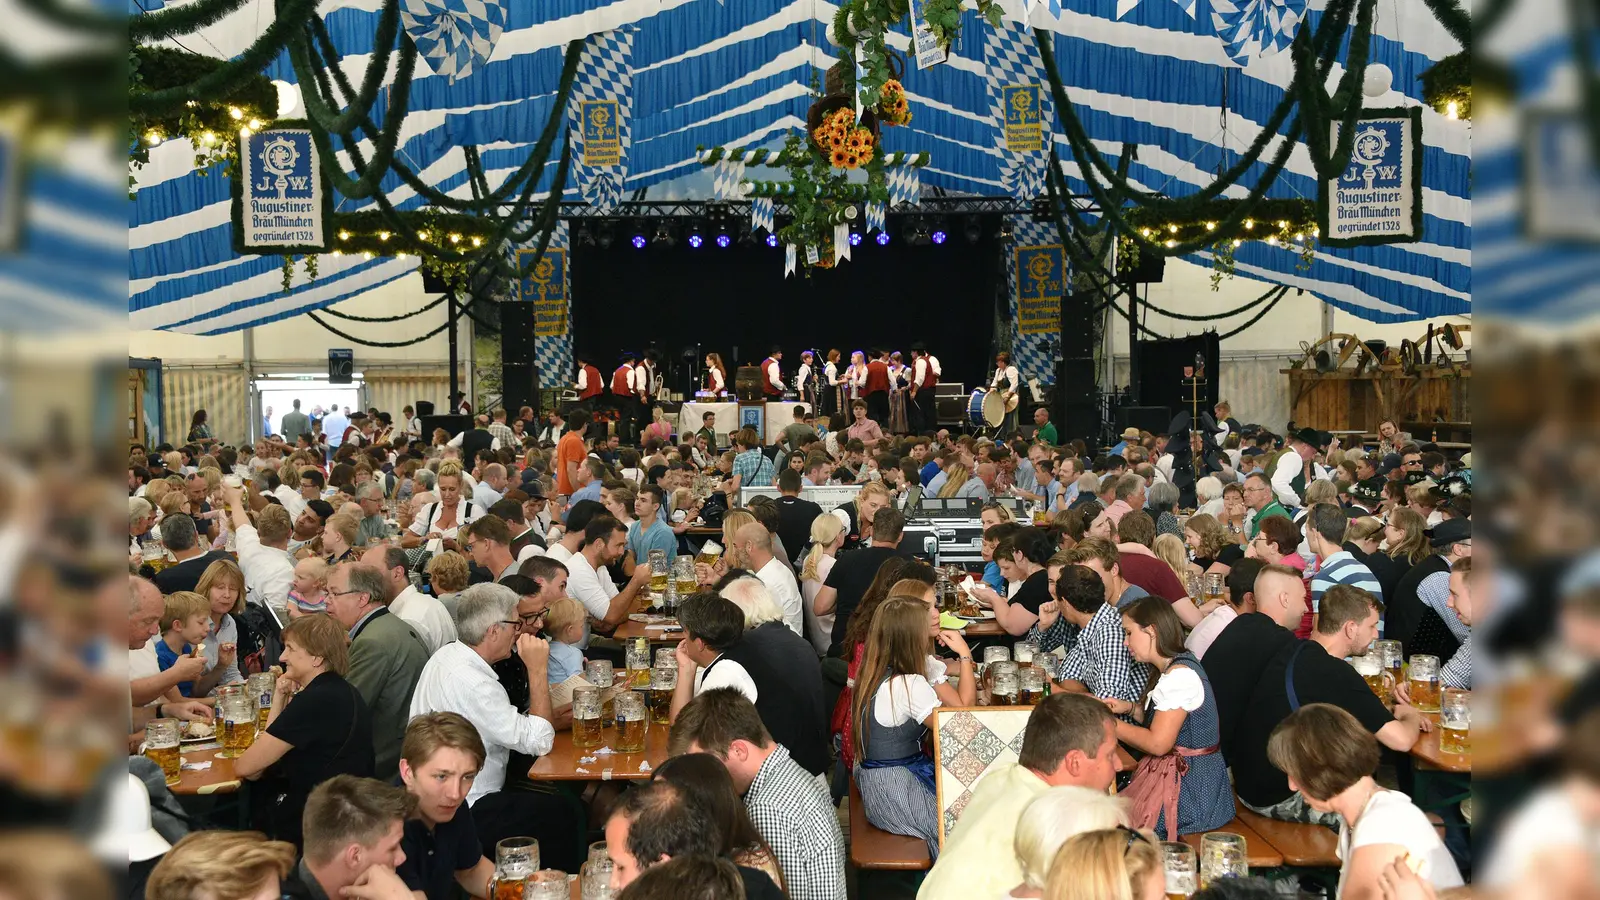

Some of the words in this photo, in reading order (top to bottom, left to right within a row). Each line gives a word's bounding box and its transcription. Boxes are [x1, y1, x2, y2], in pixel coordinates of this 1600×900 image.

[1343, 167, 1361, 181] J.
[1376, 165, 1398, 180] W.
[257, 176, 274, 191] J.
[288, 176, 308, 190] W.
[1337, 206, 1359, 219] Bräu
[1359, 206, 1400, 218] München
[252, 214, 273, 228] Bräu
[275, 214, 313, 227] München
[1338, 222, 1381, 234] gegründet
[1382, 221, 1400, 230] 1328
[253, 232, 295, 242] gegründet
[296, 231, 314, 240] 1328
[330, 360, 352, 376] WC
